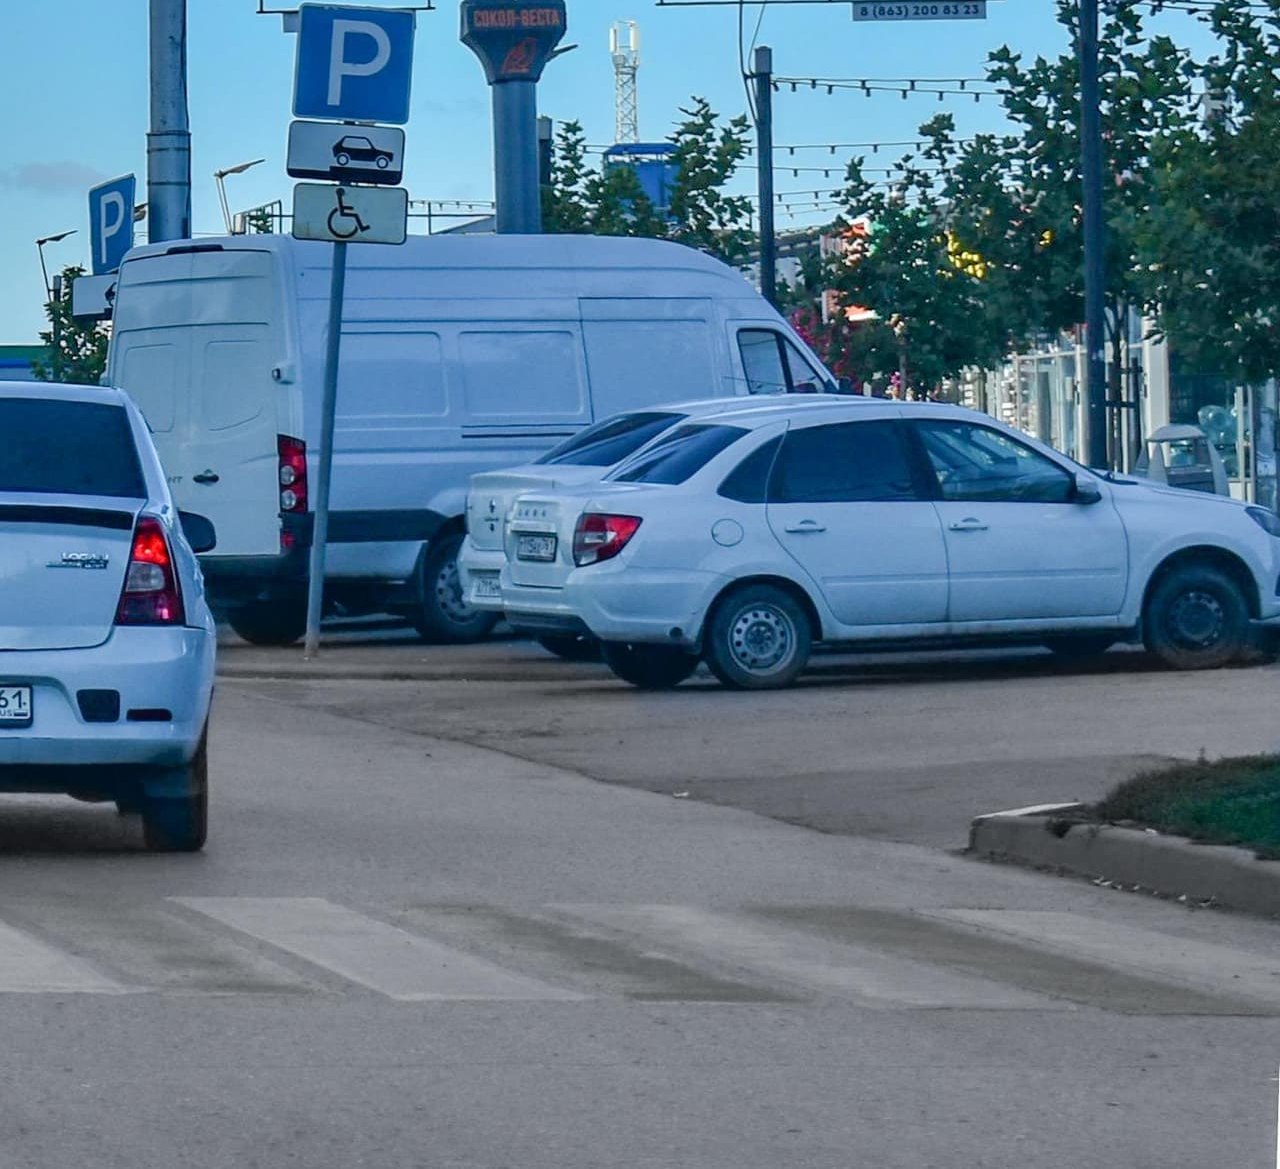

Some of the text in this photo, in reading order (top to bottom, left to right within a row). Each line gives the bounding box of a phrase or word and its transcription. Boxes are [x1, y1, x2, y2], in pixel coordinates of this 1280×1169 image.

[860, 4, 979, 18] 8 (863) 200 83 23
[327, 19, 391, 106] P
[100, 191, 125, 264] P
